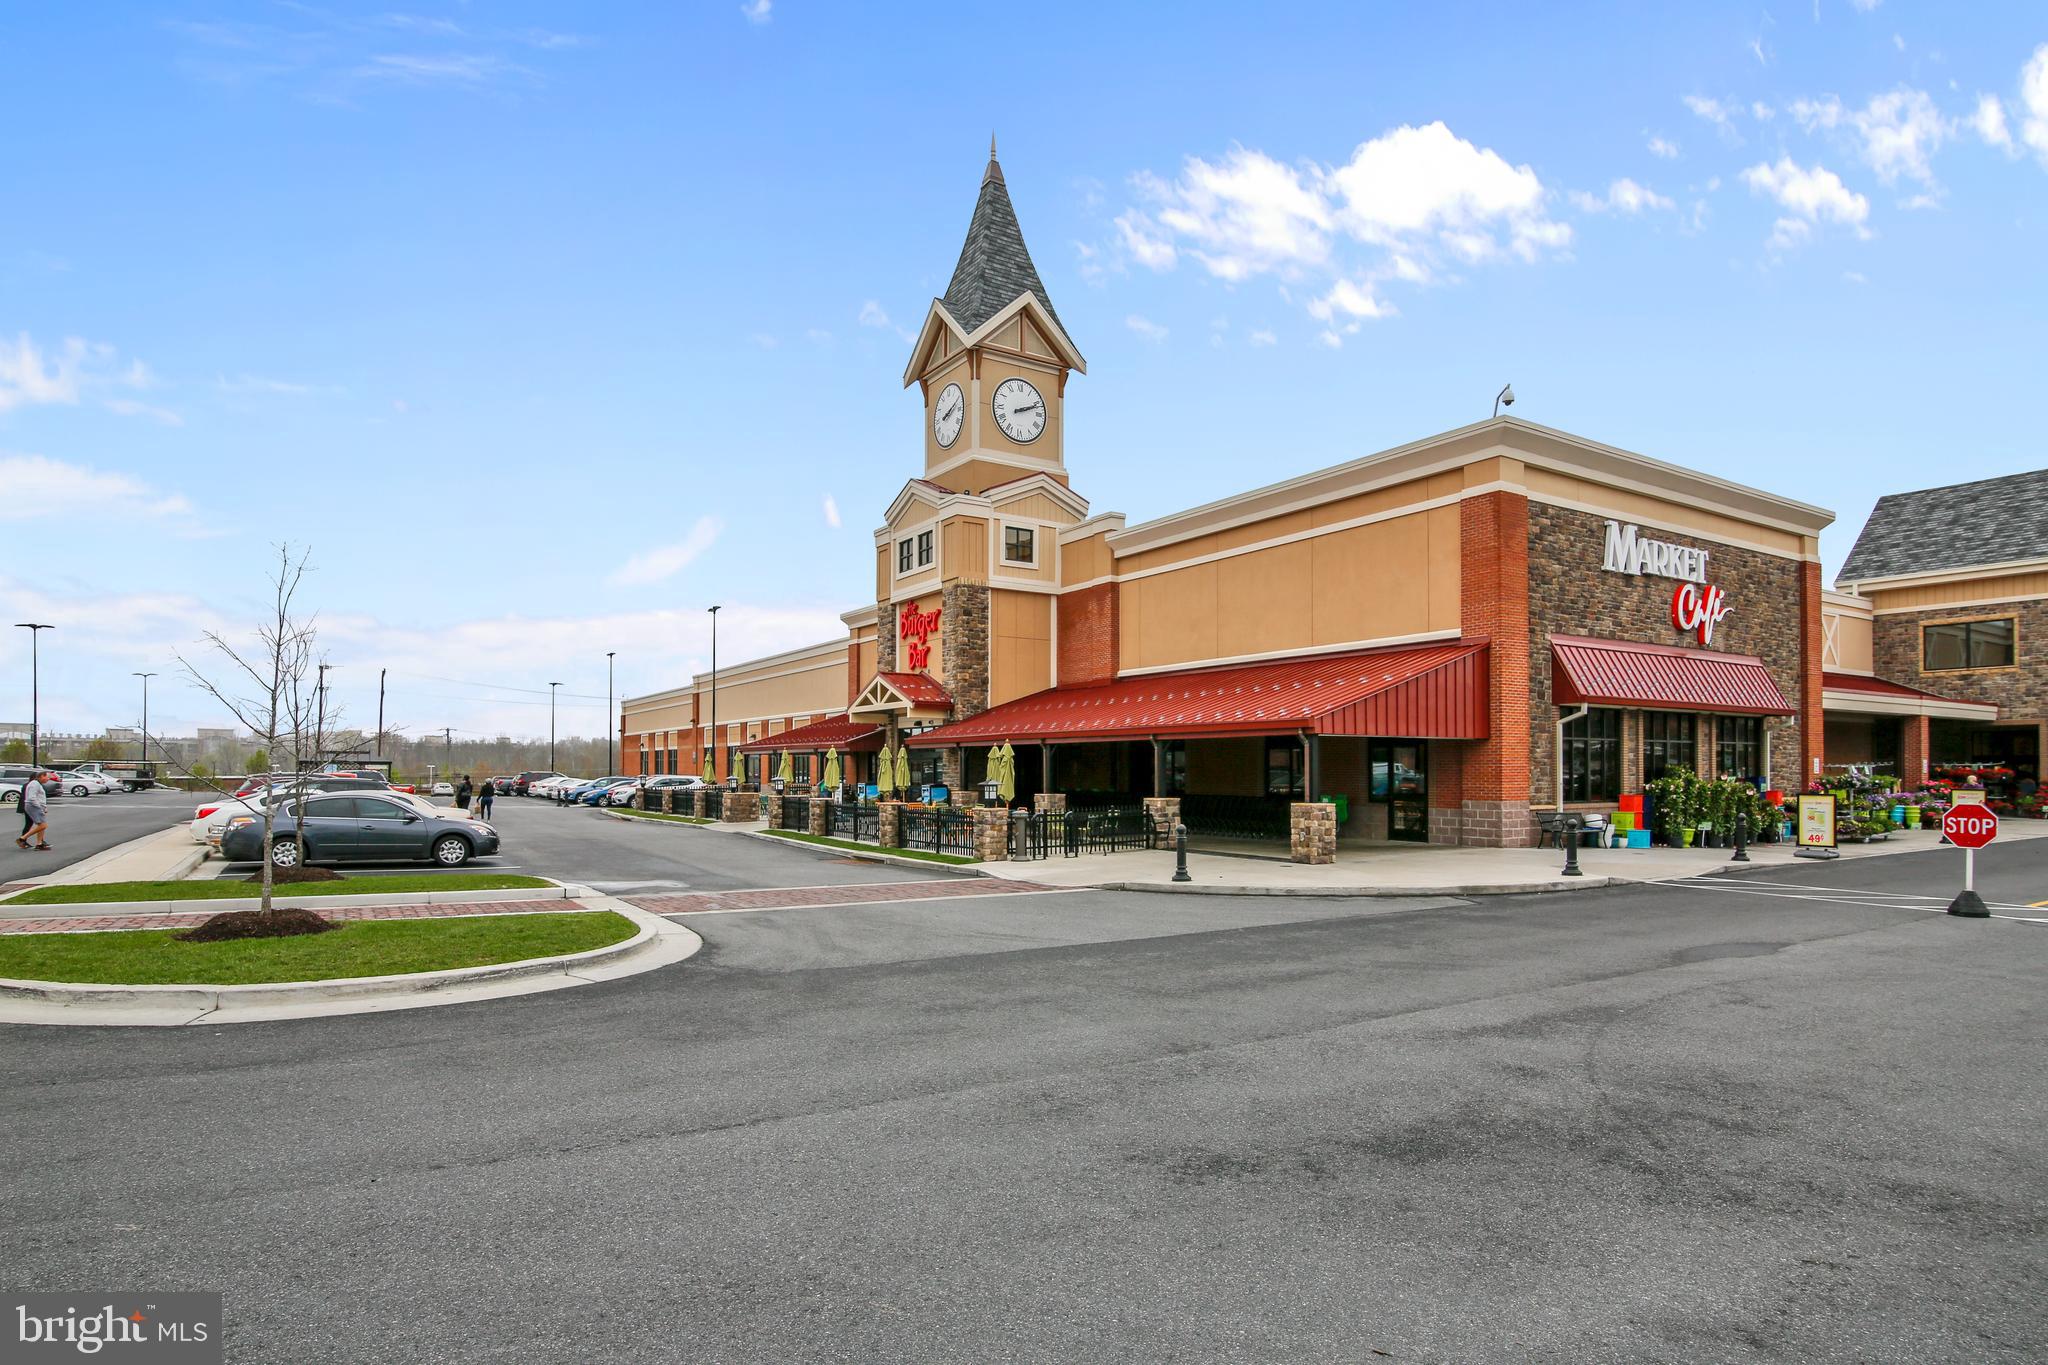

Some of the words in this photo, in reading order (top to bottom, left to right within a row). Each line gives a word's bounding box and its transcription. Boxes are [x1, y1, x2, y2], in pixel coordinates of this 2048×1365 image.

[1601, 519, 1709, 584] MARKET
[900, 609, 942, 645] Burger
[908, 642, 931, 670] Bar
[1945, 816, 1995, 836] STOP
